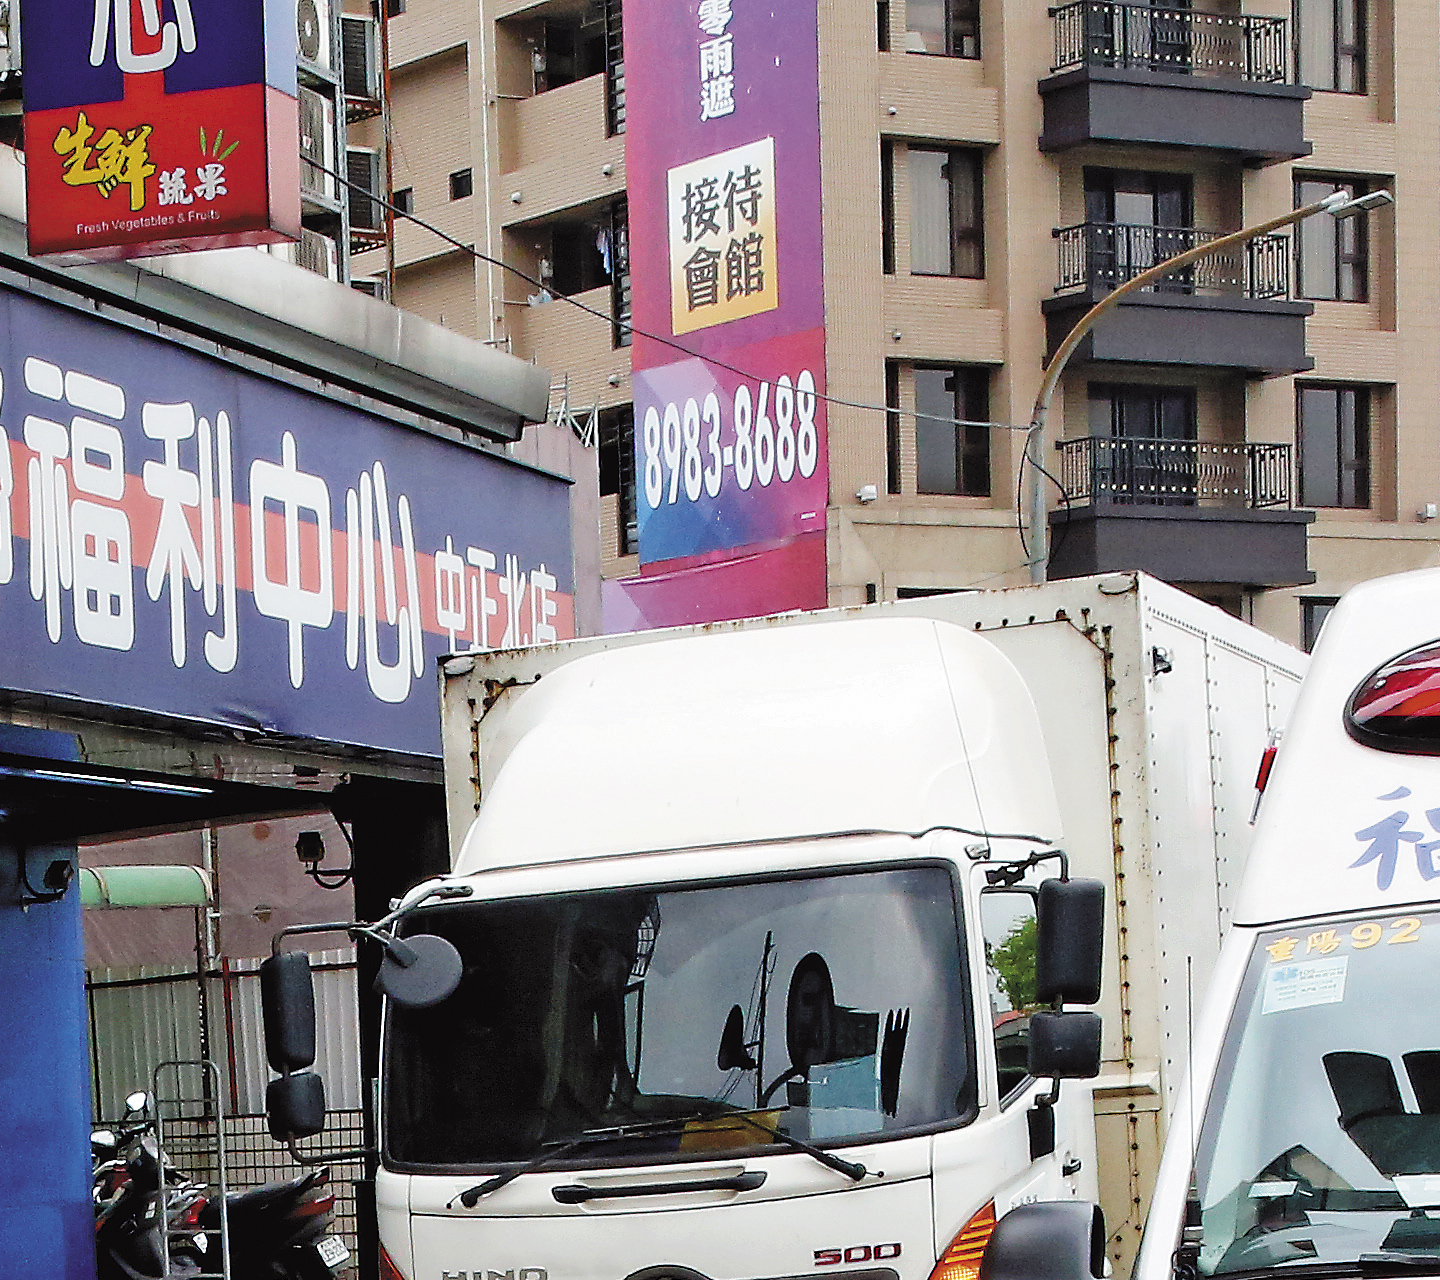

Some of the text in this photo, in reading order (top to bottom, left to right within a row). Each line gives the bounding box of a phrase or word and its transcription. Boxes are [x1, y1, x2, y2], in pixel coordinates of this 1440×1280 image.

[77, 209, 220, 235] Fresh Vegetables & Fruits
[681, 164, 763, 244] 接待
[683, 231, 764, 313] 會館
[644, 369, 818, 510] 8983-8688
[814, 1242, 902, 1266] 500
